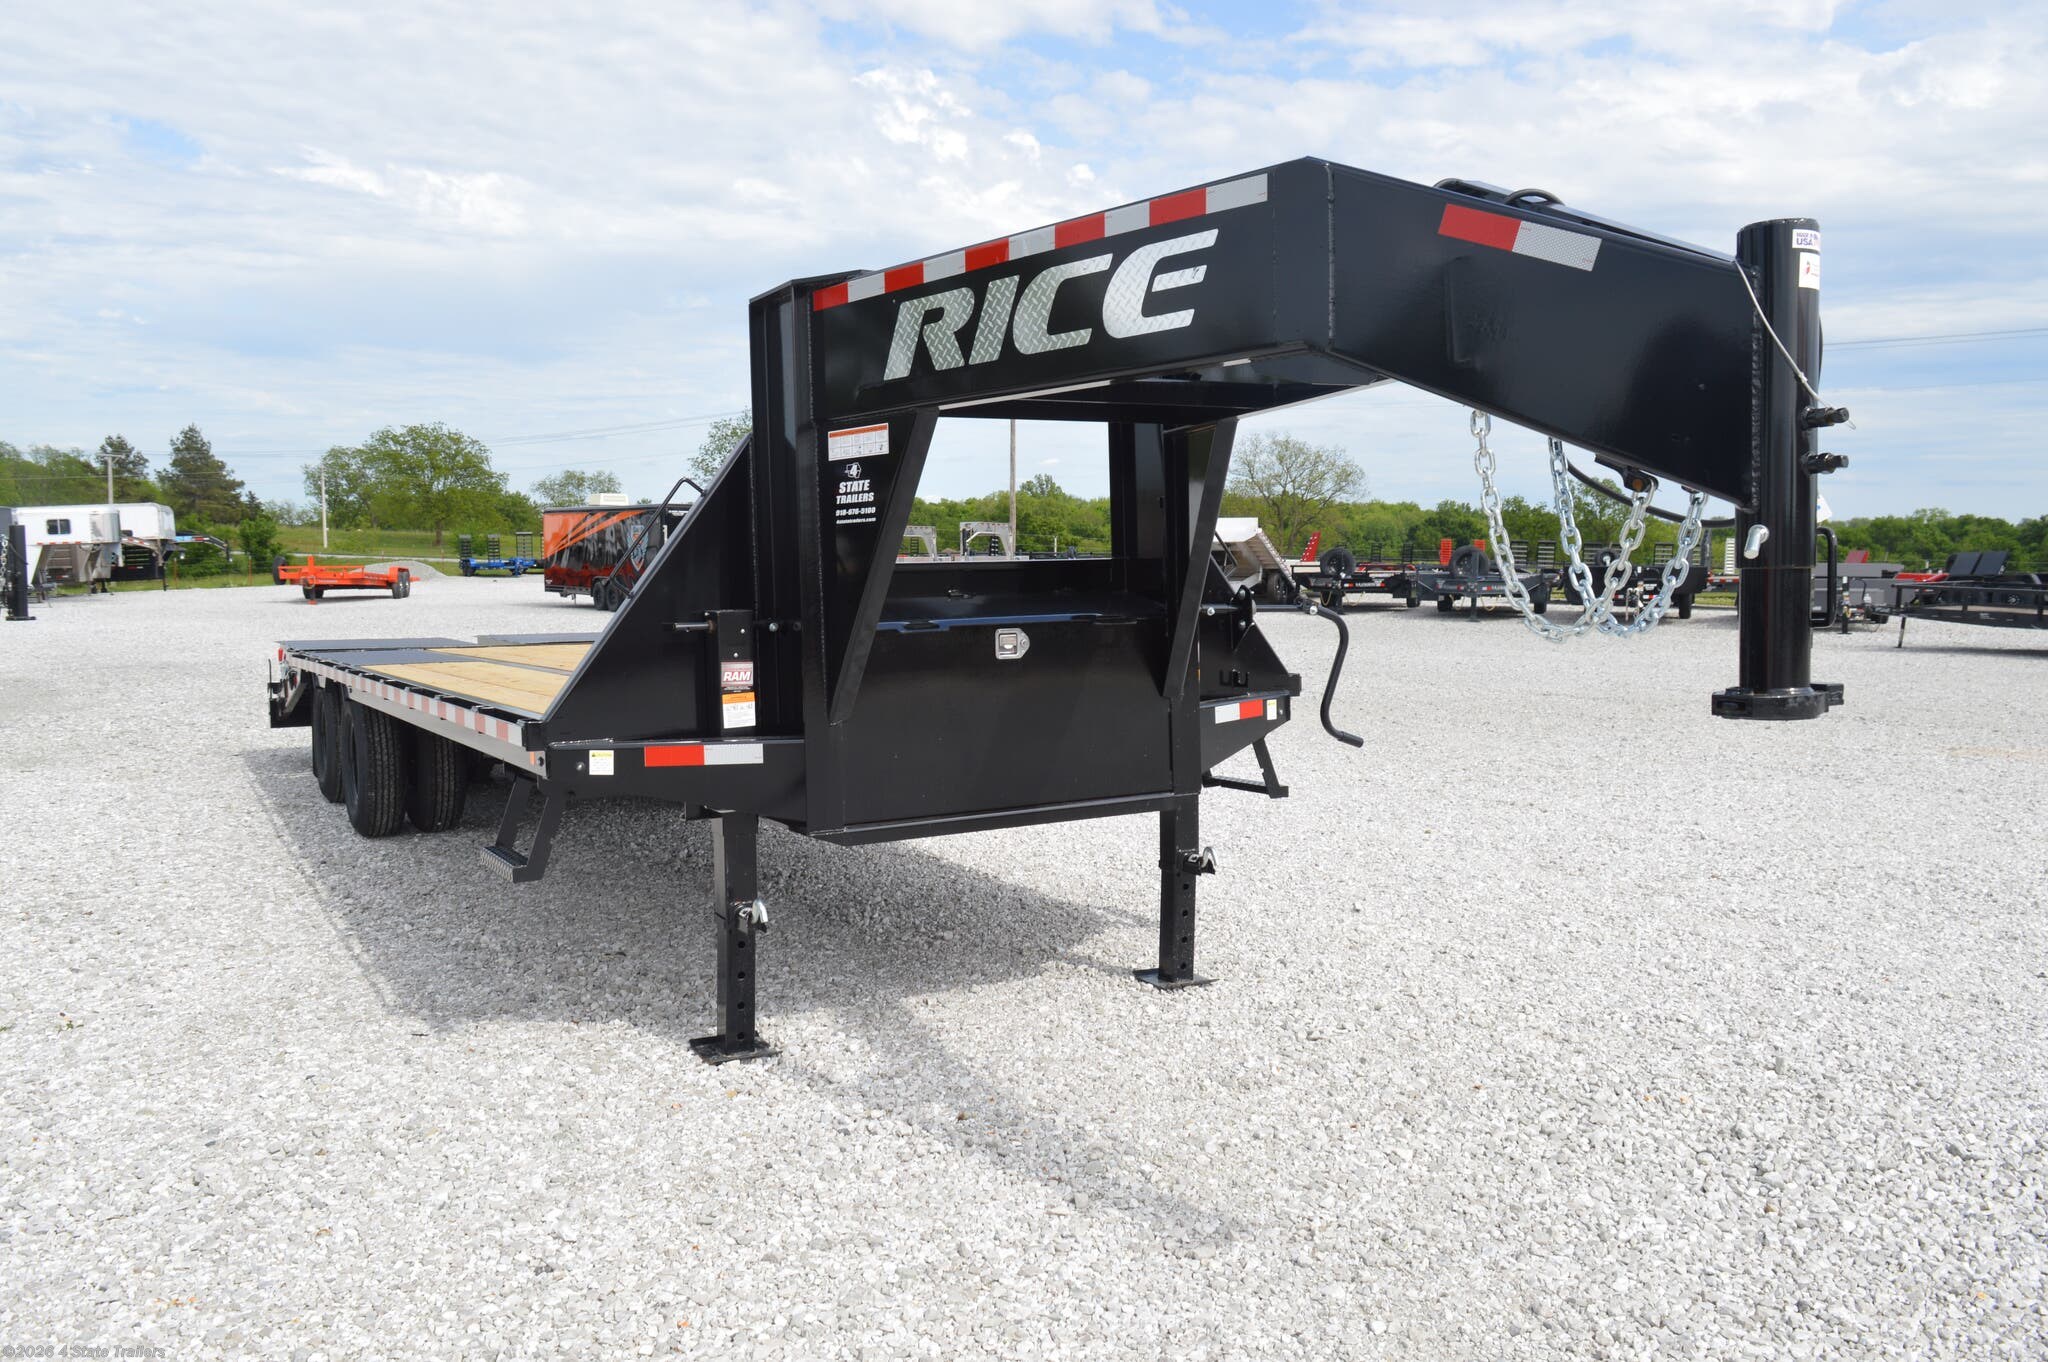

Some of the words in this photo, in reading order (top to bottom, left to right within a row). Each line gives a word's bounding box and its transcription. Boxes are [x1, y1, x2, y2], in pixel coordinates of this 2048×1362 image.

[1796, 237, 1813, 246] USA
[884, 229, 1219, 381] RICE
[839, 480, 870, 494] STATE
[836, 492, 875, 505] TRAILERS
[723, 671, 751, 682] RAM
